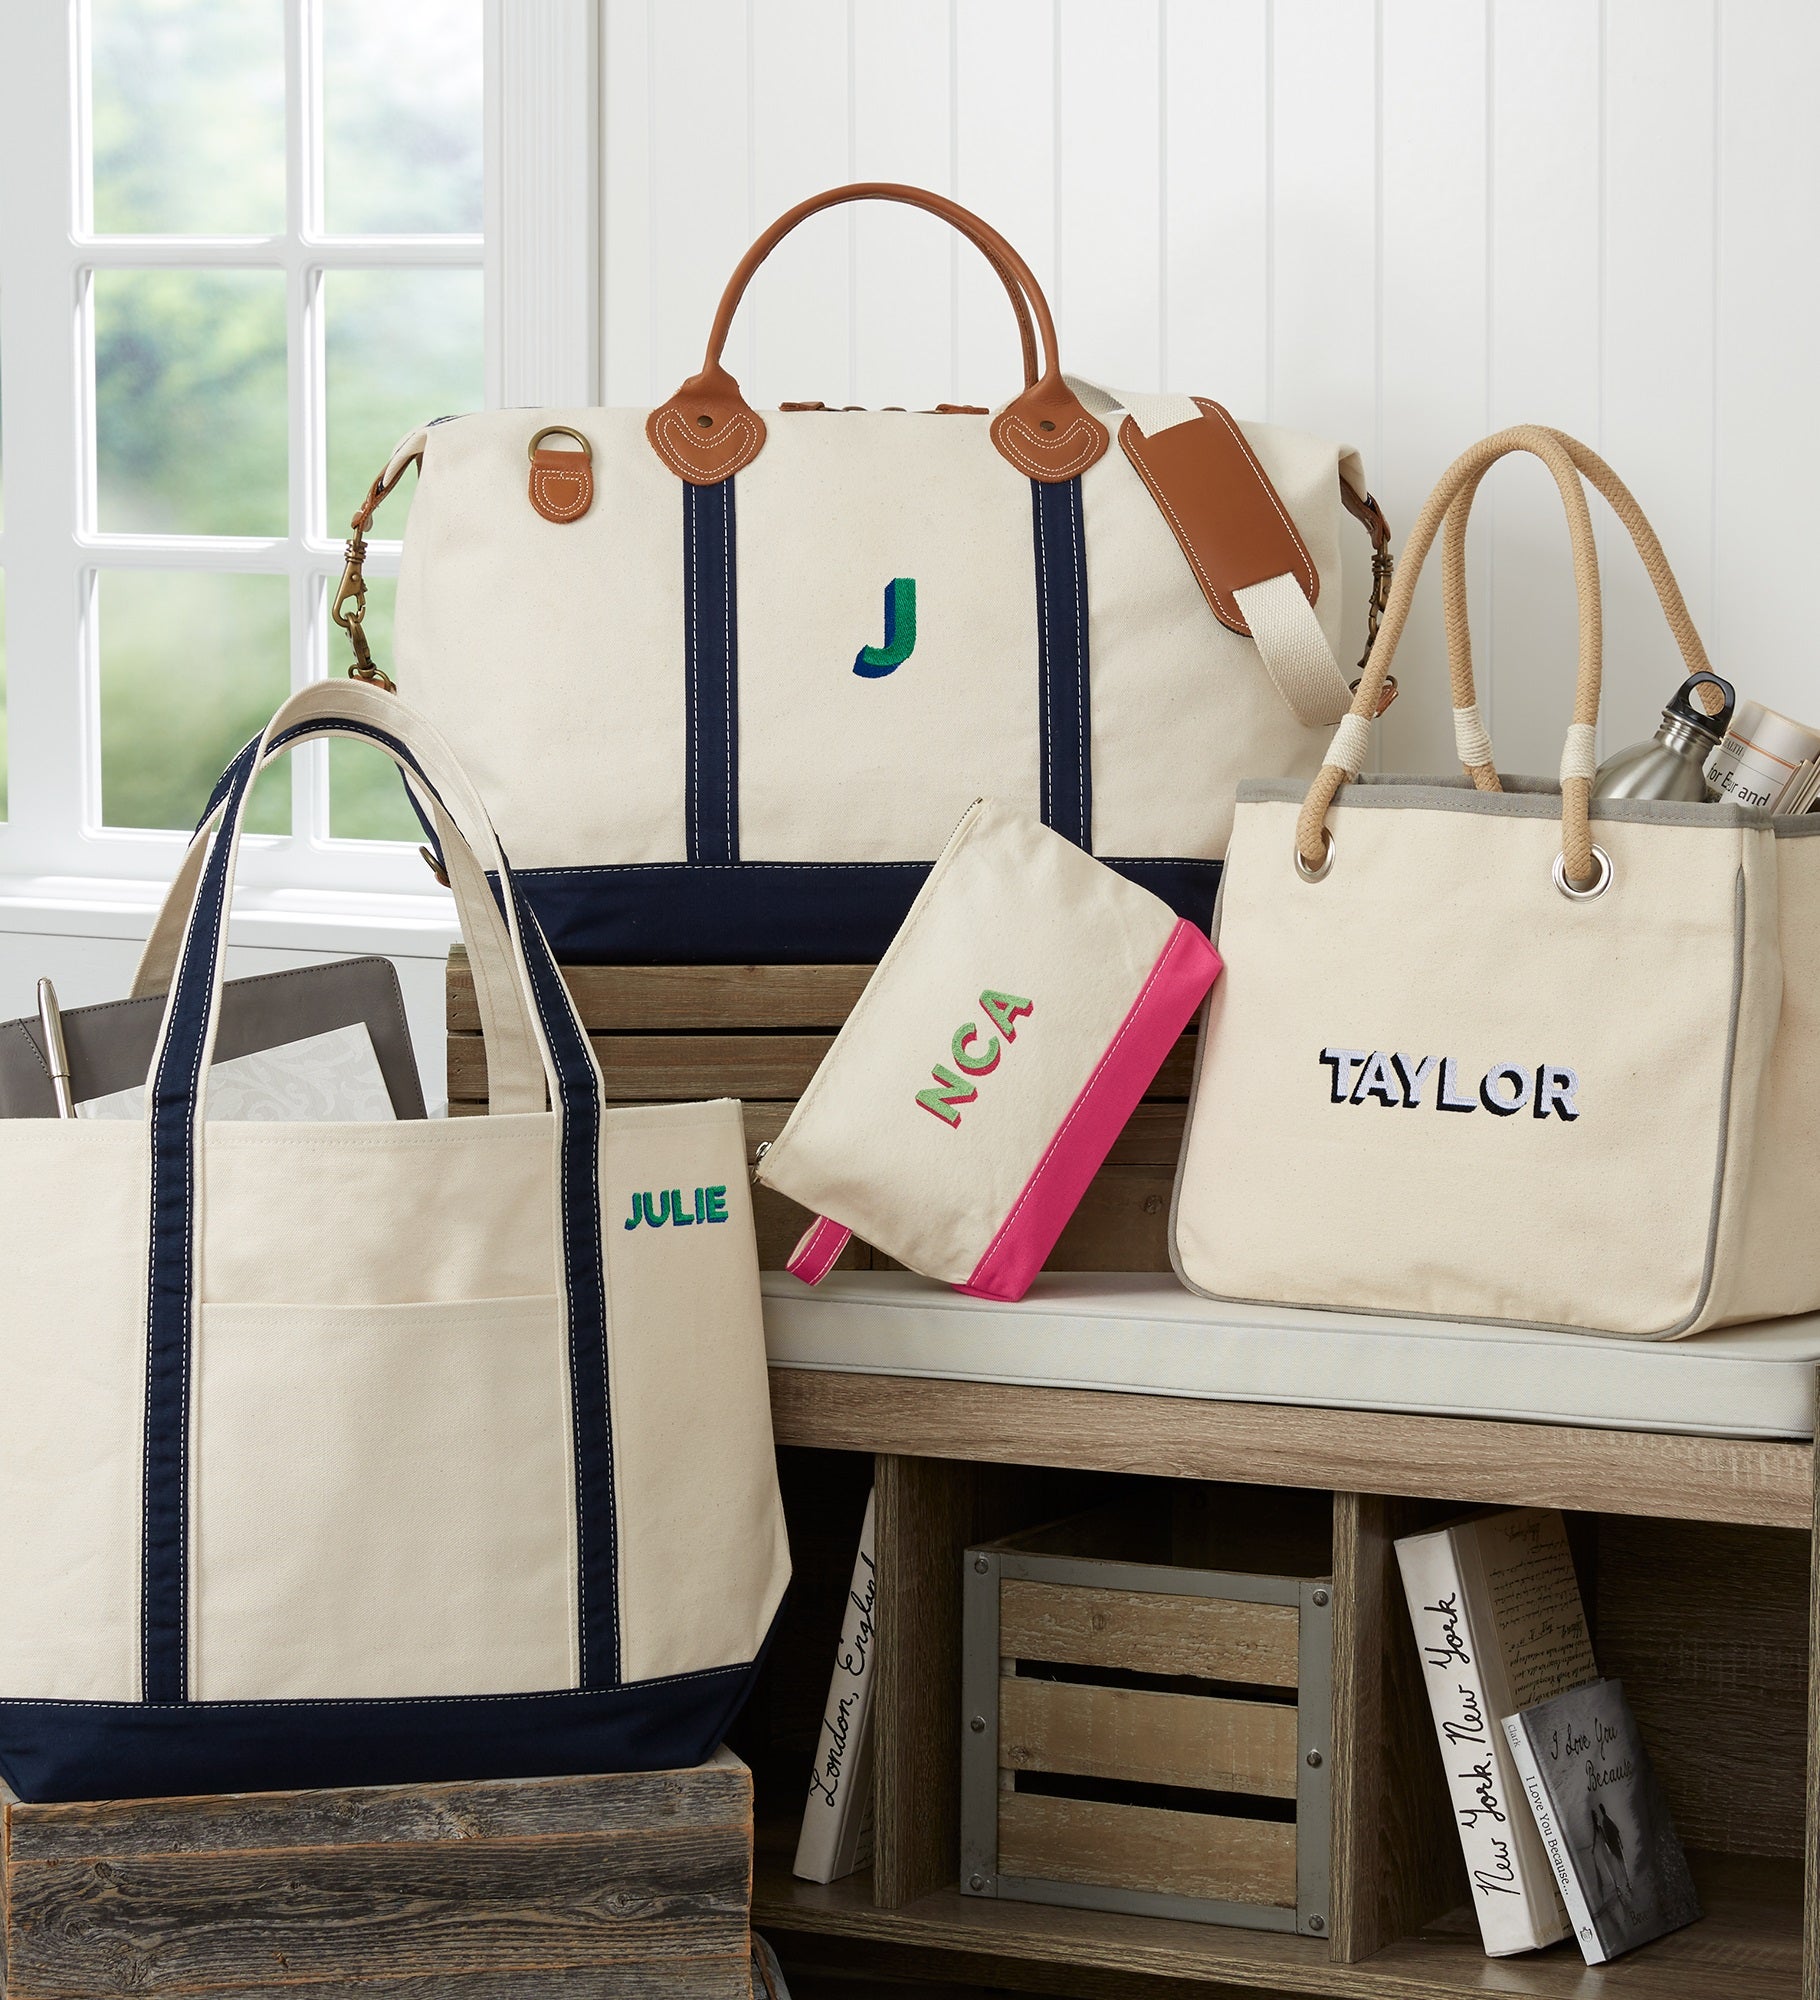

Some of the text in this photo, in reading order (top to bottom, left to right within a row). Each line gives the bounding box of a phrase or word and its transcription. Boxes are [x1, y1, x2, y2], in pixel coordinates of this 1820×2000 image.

[852, 577, 917, 679] J
[1738, 786, 1771, 807] and
[915, 989, 1034, 1129] NCA
[1319, 1047, 1580, 1121] TAYLOR
[624, 1185, 729, 1231] JULIE
[809, 1692, 859, 1807] London,
[1424, 1591, 1521, 1896] New York, New York
[1507, 1724, 1521, 1748] Clark
[1550, 1717, 1619, 1761] I Love You
[1528, 1784, 1544, 1811] Love
[1539, 1812, 1553, 1837] You
